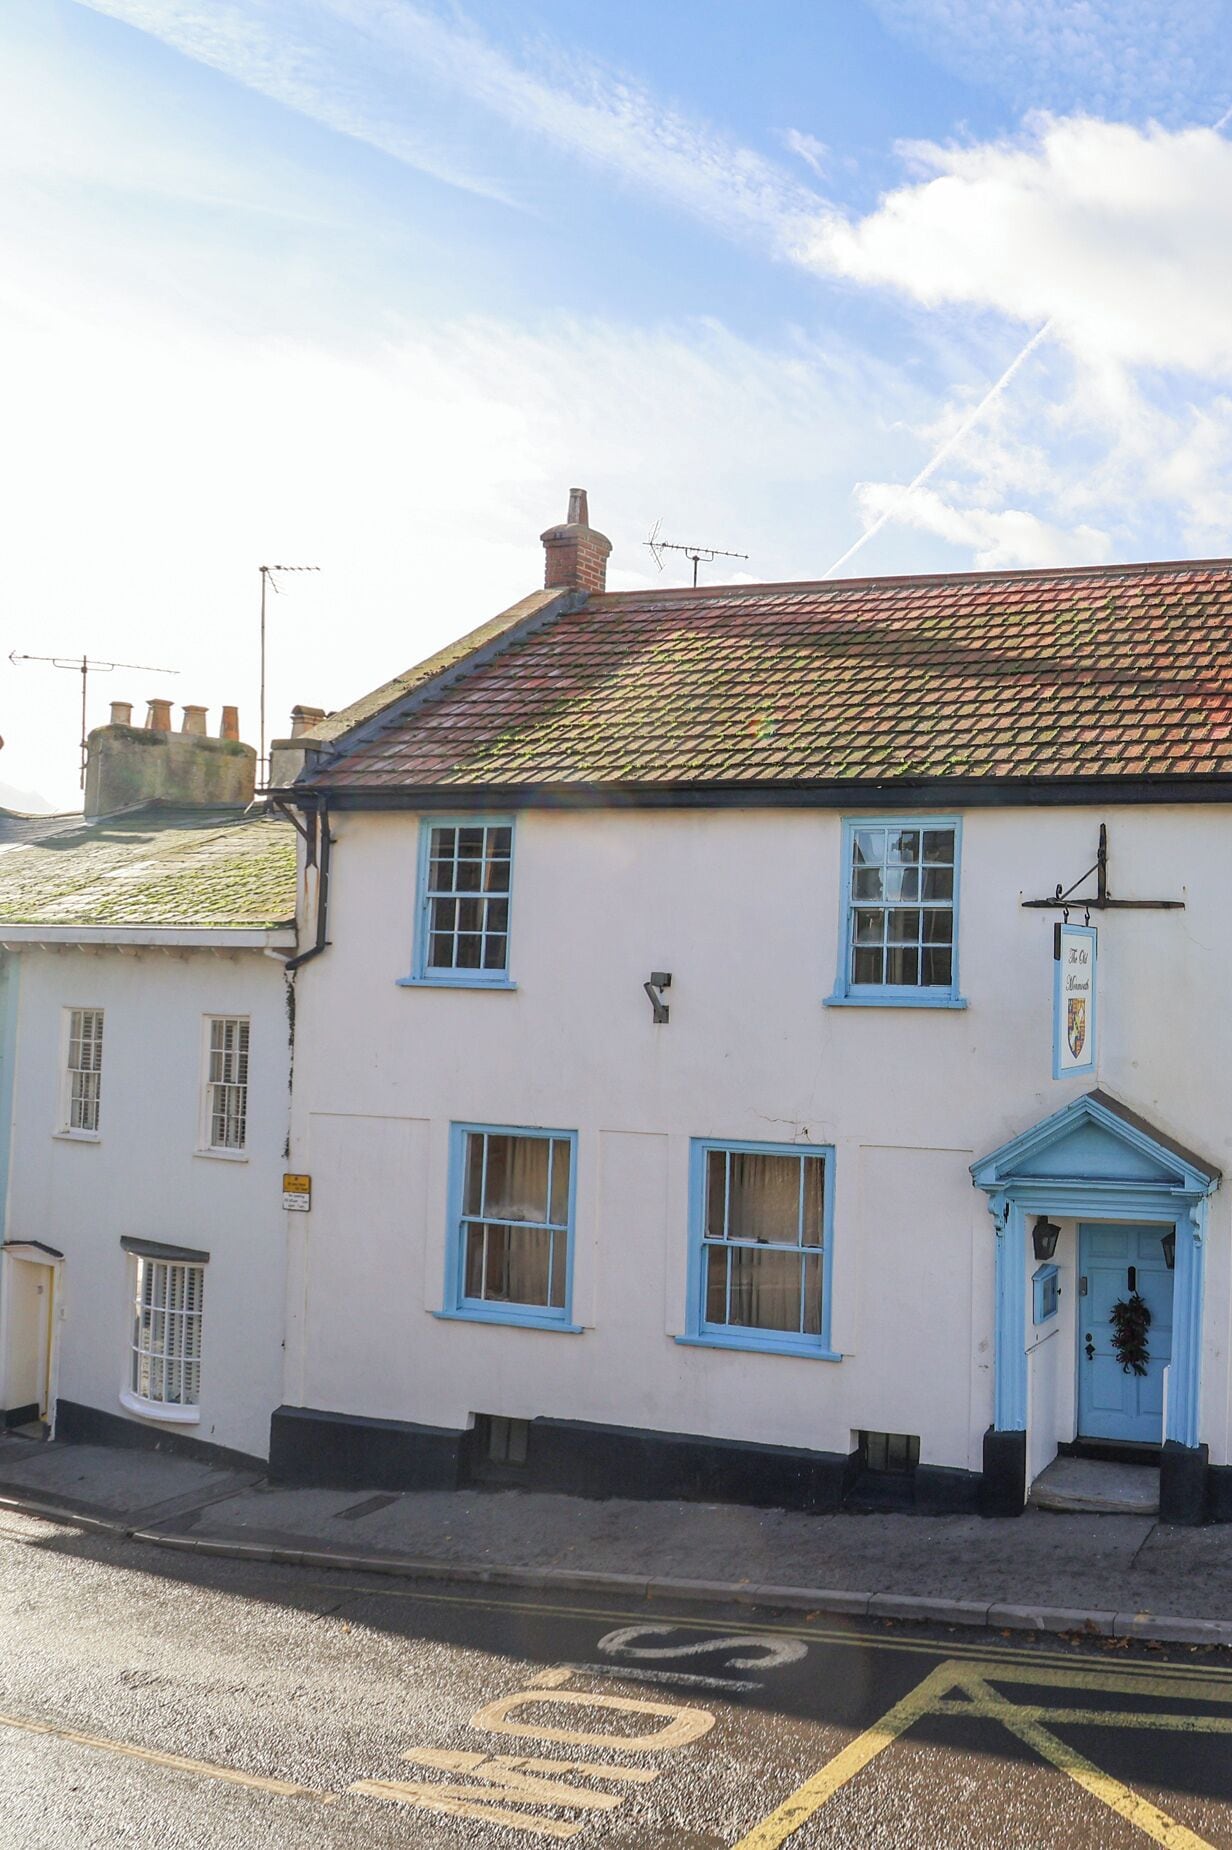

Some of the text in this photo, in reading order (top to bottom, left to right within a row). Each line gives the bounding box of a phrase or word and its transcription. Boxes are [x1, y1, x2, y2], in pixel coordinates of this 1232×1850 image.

[1069, 947, 1089, 965] The Old
[348, 1624, 809, 1839] SLOW
